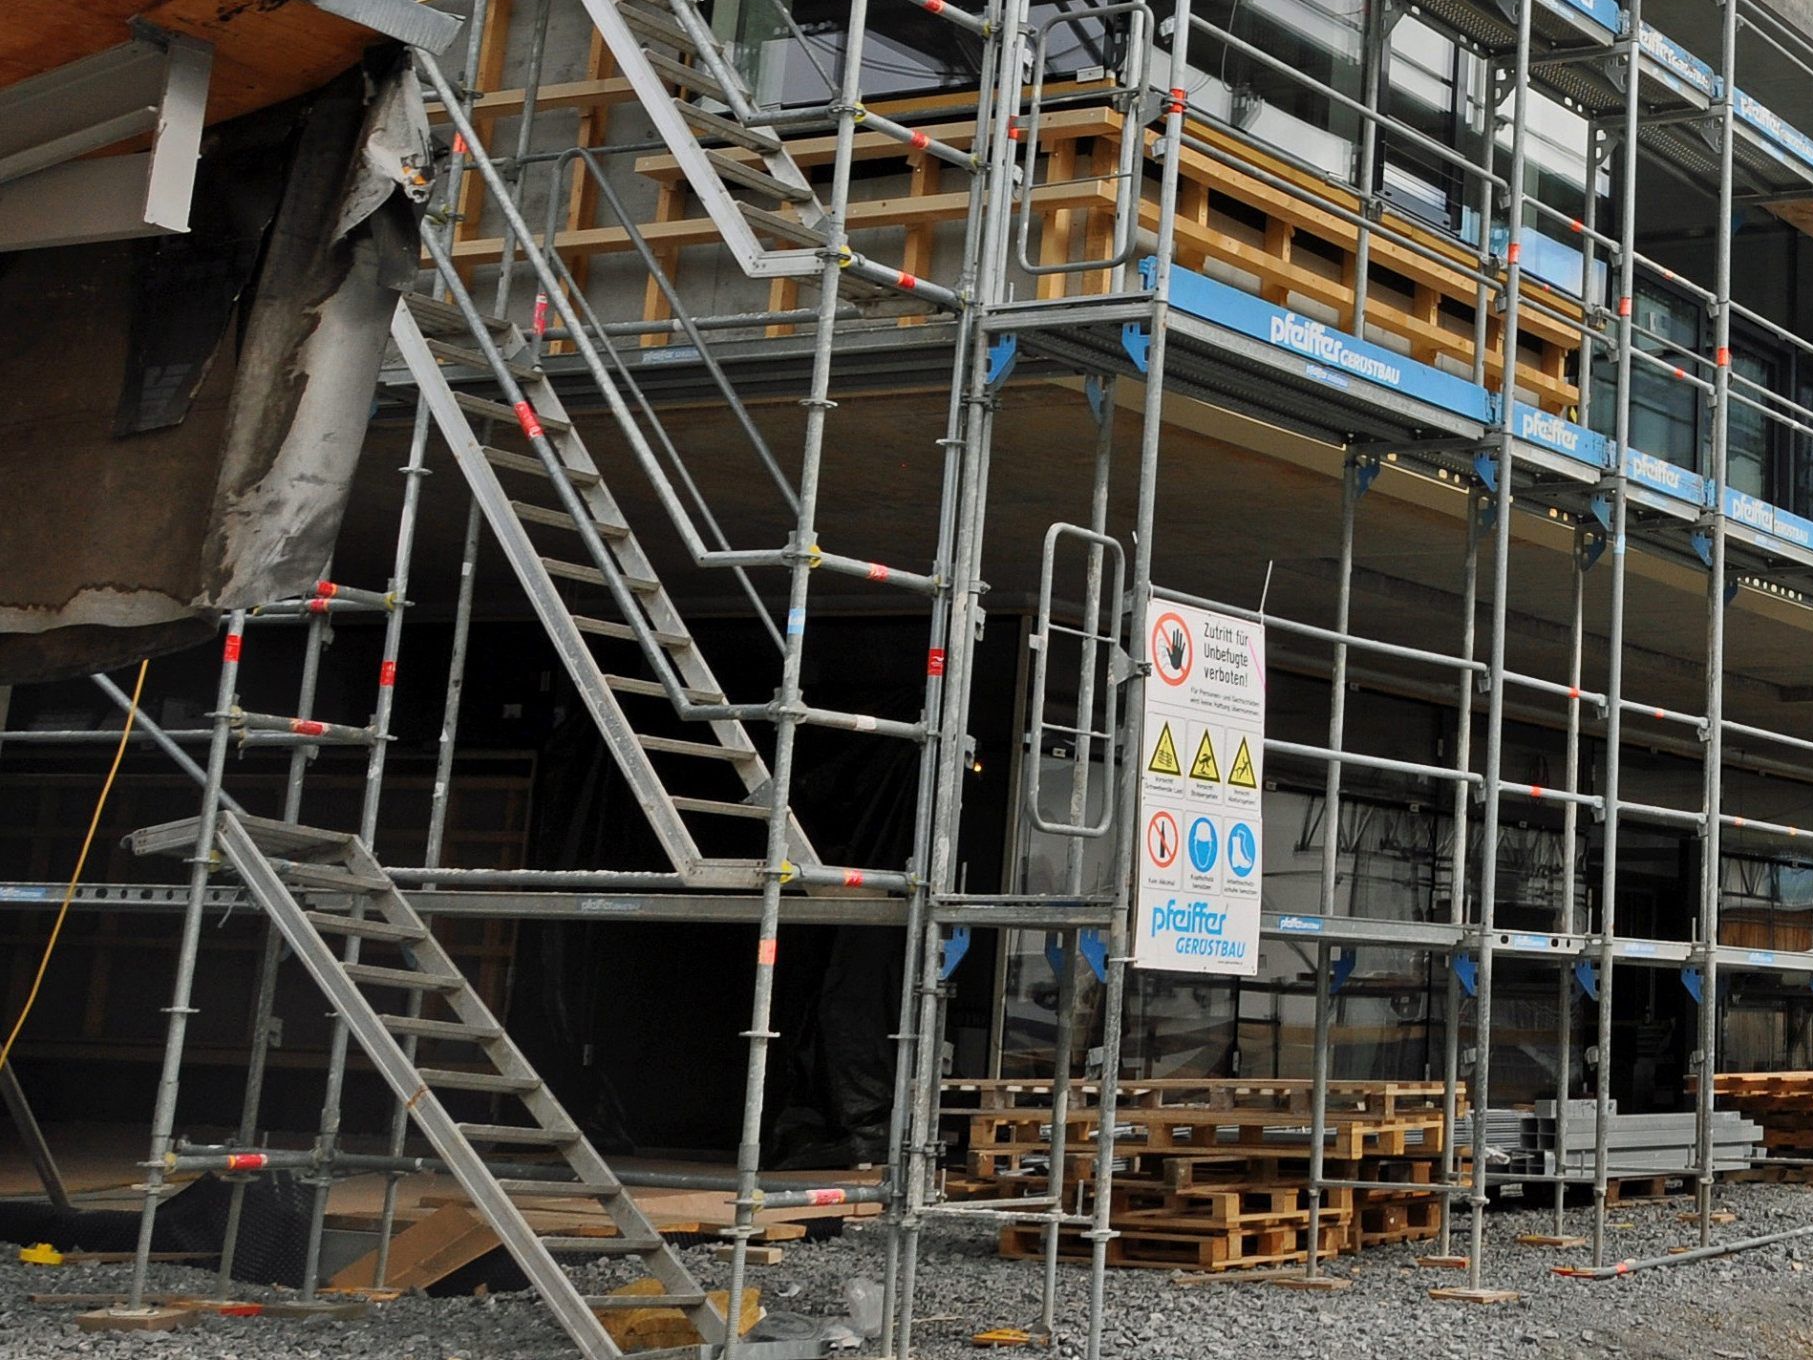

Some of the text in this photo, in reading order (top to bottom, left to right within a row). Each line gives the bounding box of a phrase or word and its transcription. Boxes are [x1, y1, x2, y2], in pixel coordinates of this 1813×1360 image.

[1271, 312, 1343, 363] pfeiffer
[1522, 412, 1578, 452] pfeiffer
[1632, 453, 1681, 489] pfeiffer
[1732, 493, 1774, 534] pfeiffer
[1204, 622, 1249, 647] Zutritt für
[1204, 643, 1248, 669] Unbefugte
[1203, 666, 1248, 688] verboten!
[1151, 898, 1227, 938] pfeiffer
[1176, 937, 1247, 959] GERÜSTBAU
